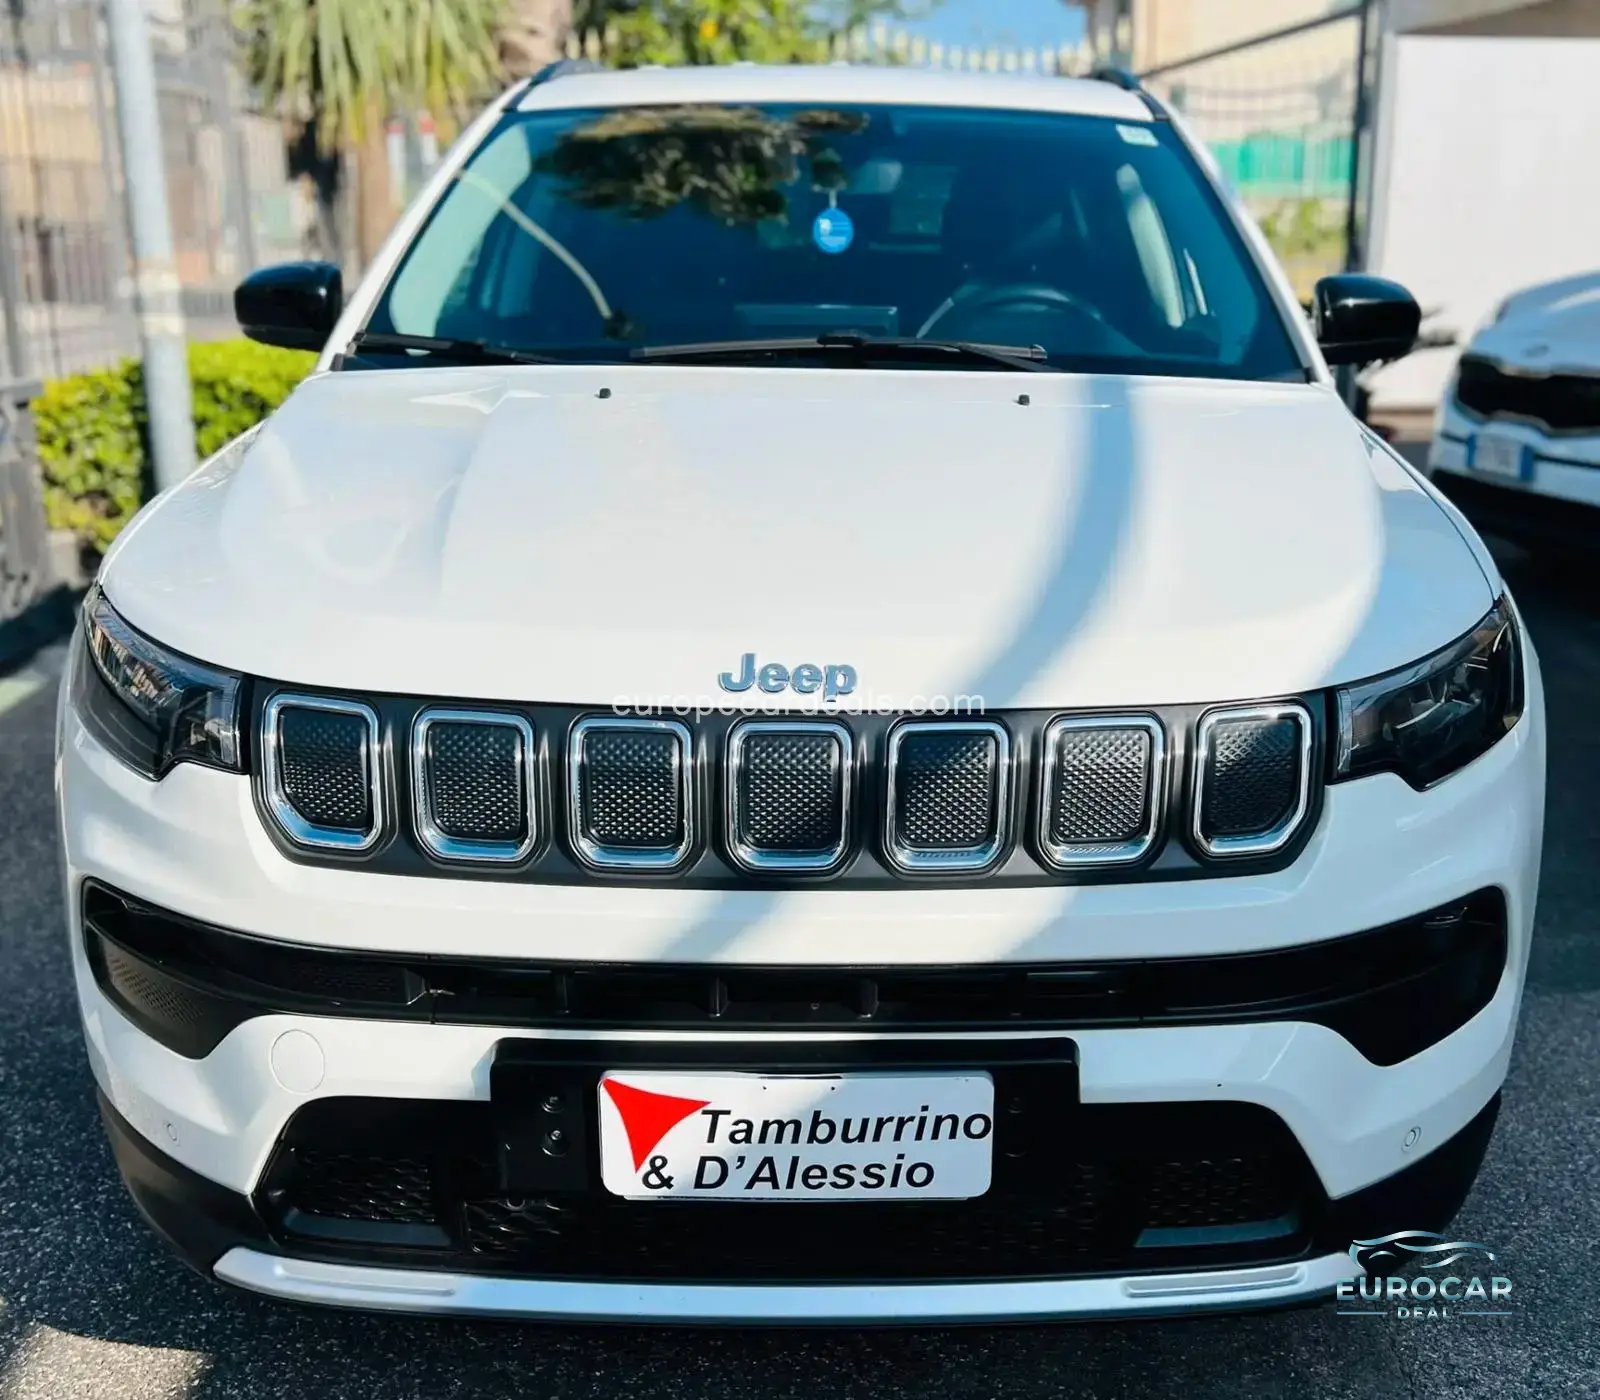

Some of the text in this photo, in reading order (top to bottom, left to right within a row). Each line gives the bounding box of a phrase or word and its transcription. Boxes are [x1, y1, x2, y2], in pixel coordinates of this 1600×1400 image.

[718, 652, 858, 703] Jeep
[701, 1105, 992, 1145] Tamburrino
[642, 1153, 935, 1190] & D’Alessio
